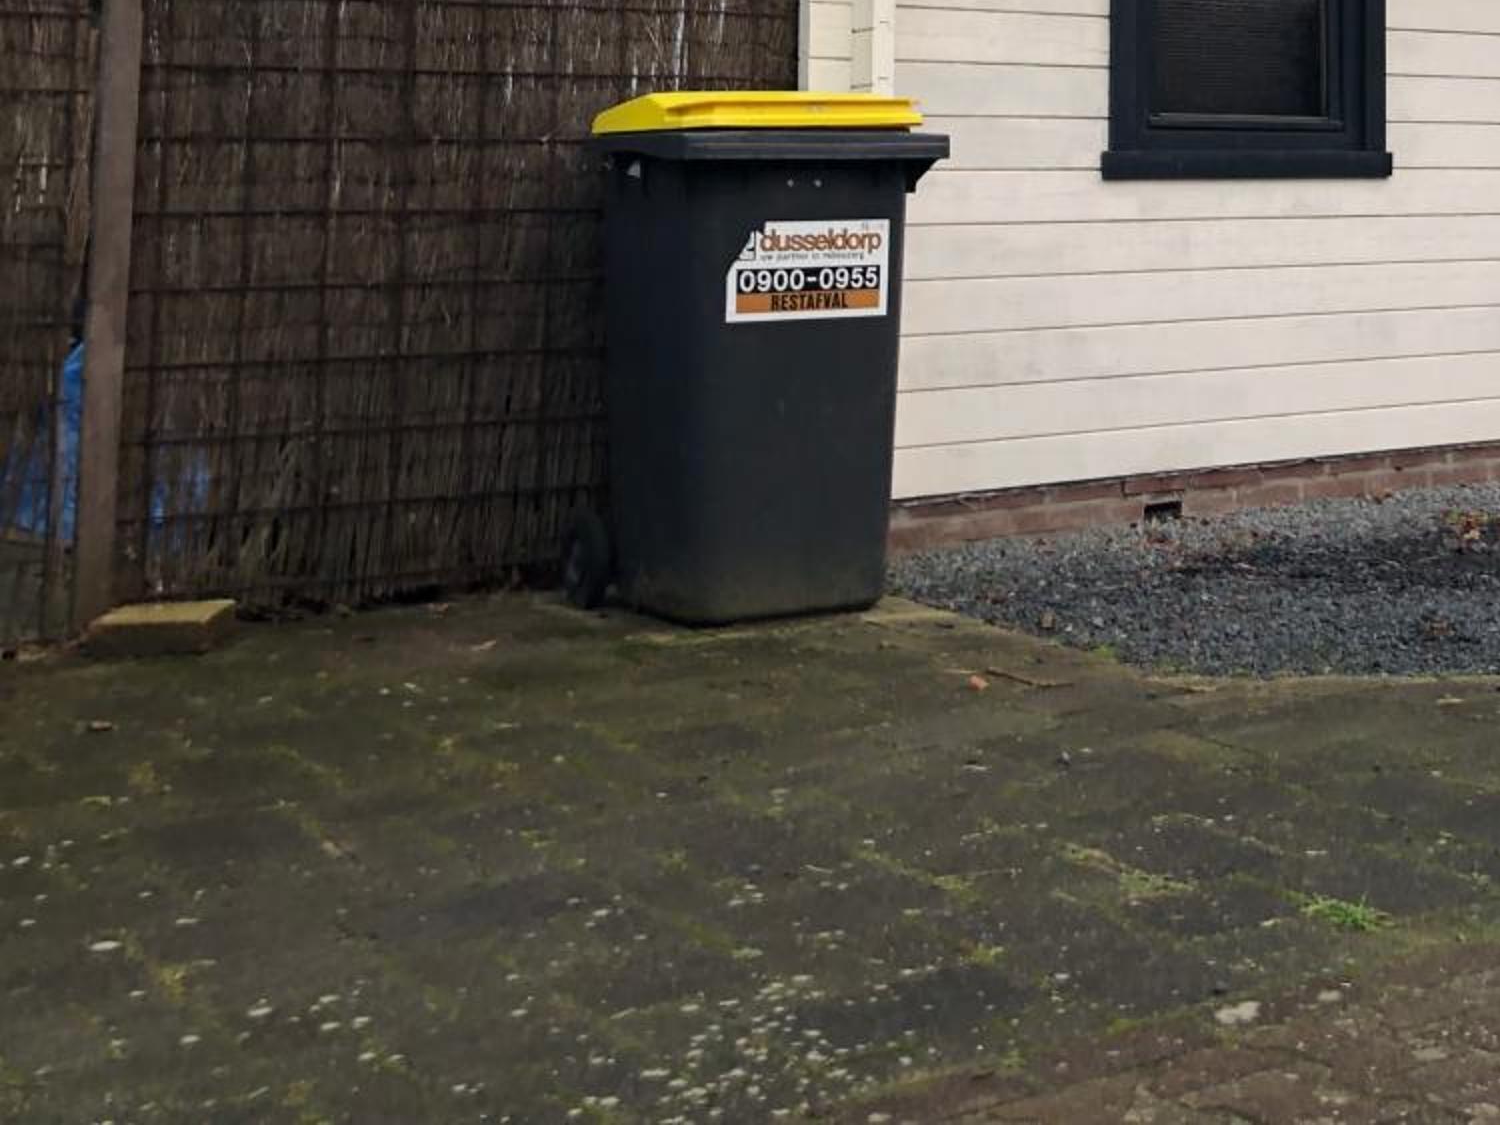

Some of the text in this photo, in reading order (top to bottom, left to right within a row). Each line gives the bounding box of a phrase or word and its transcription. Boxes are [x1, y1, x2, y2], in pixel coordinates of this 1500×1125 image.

[760, 229, 881, 253] dusseldorp
[739, 266, 877, 292] 0900-0955
[770, 293, 848, 311] RESTAFVAL
